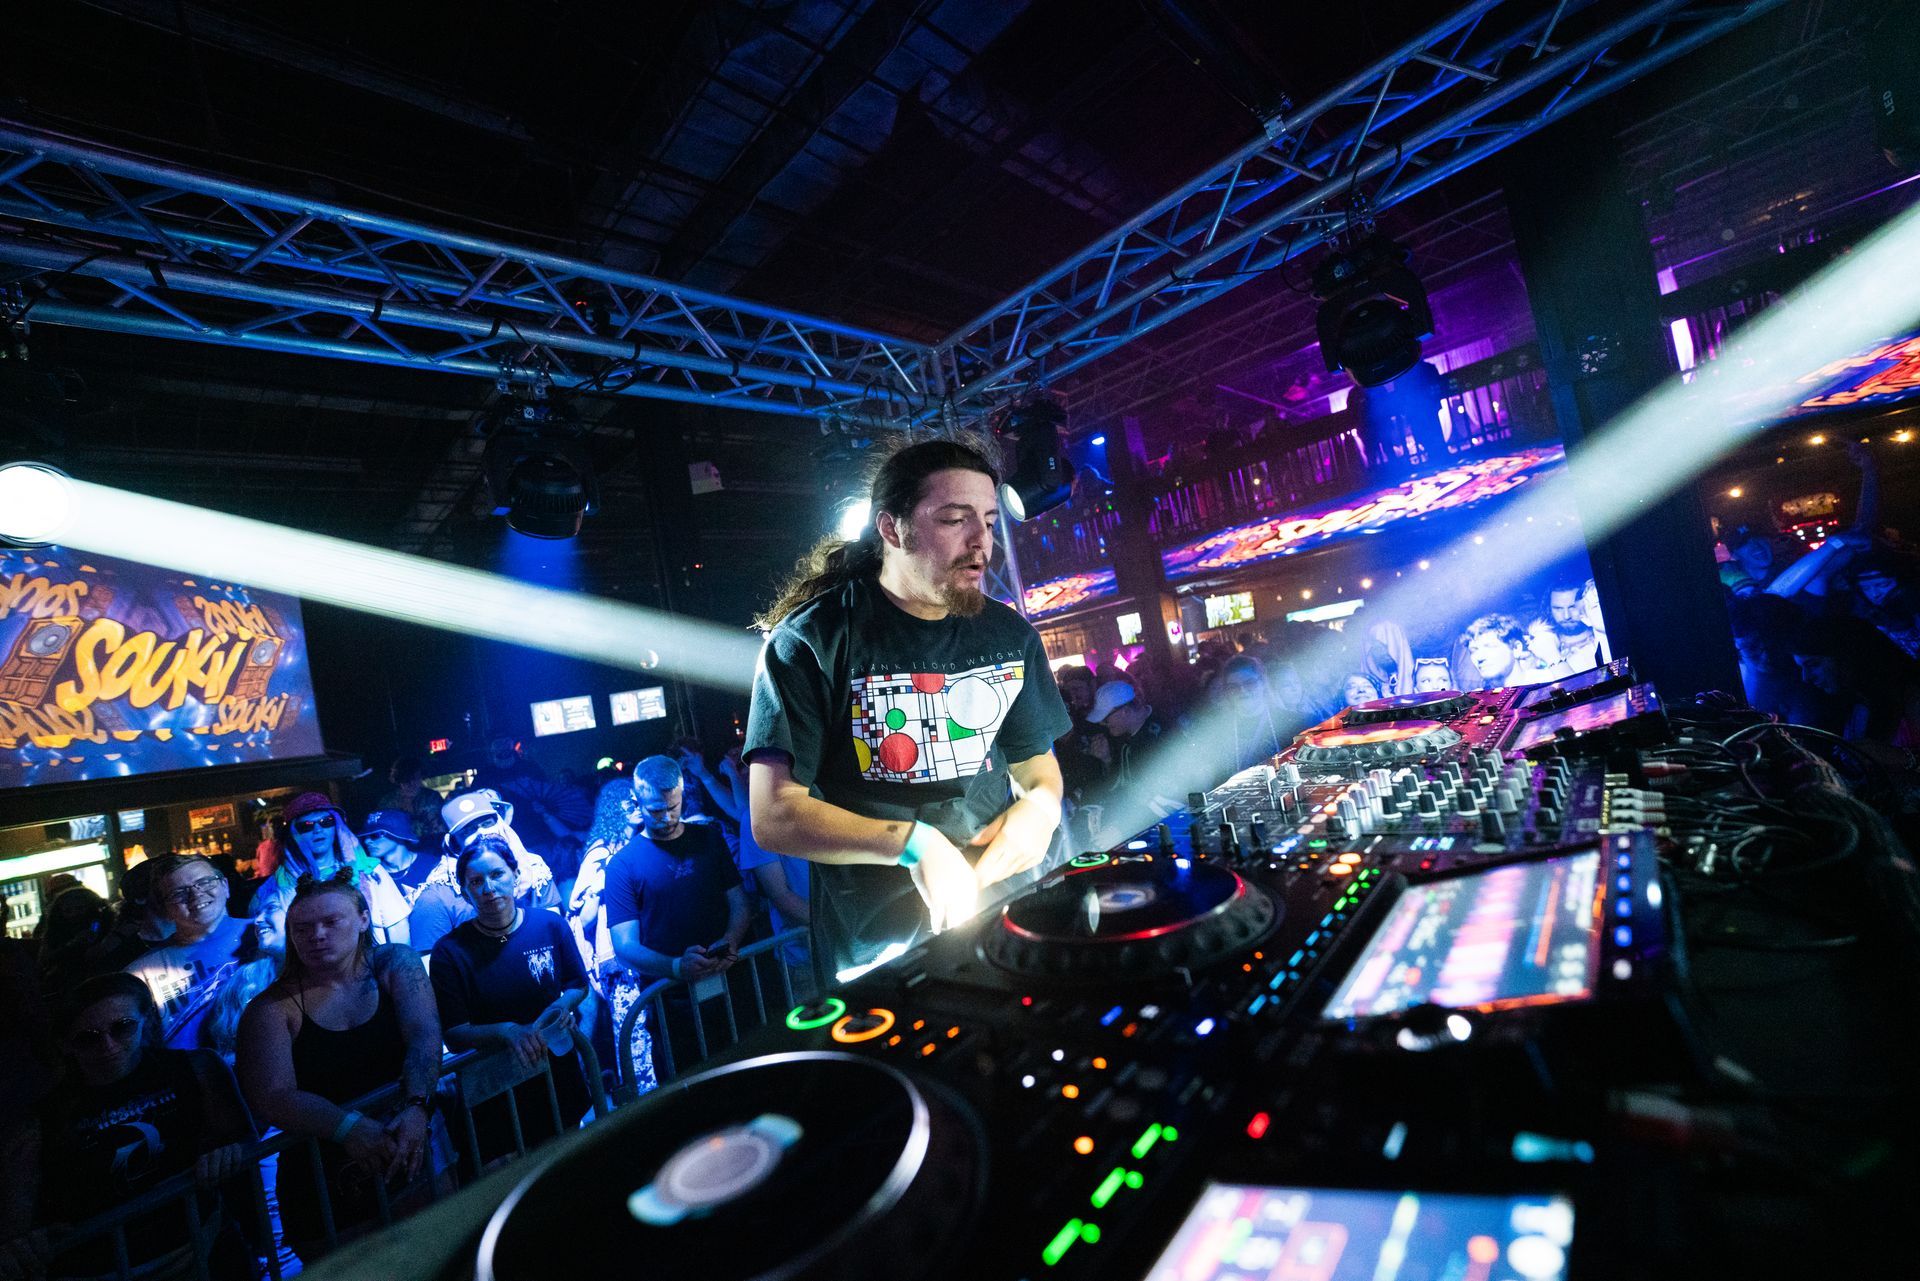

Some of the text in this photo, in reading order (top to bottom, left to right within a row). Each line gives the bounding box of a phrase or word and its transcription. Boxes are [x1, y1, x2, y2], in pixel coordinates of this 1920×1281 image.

[1883, 91, 1895, 115] LED
[851, 650, 1022, 676] FRANK LLOYD WRIGHT
